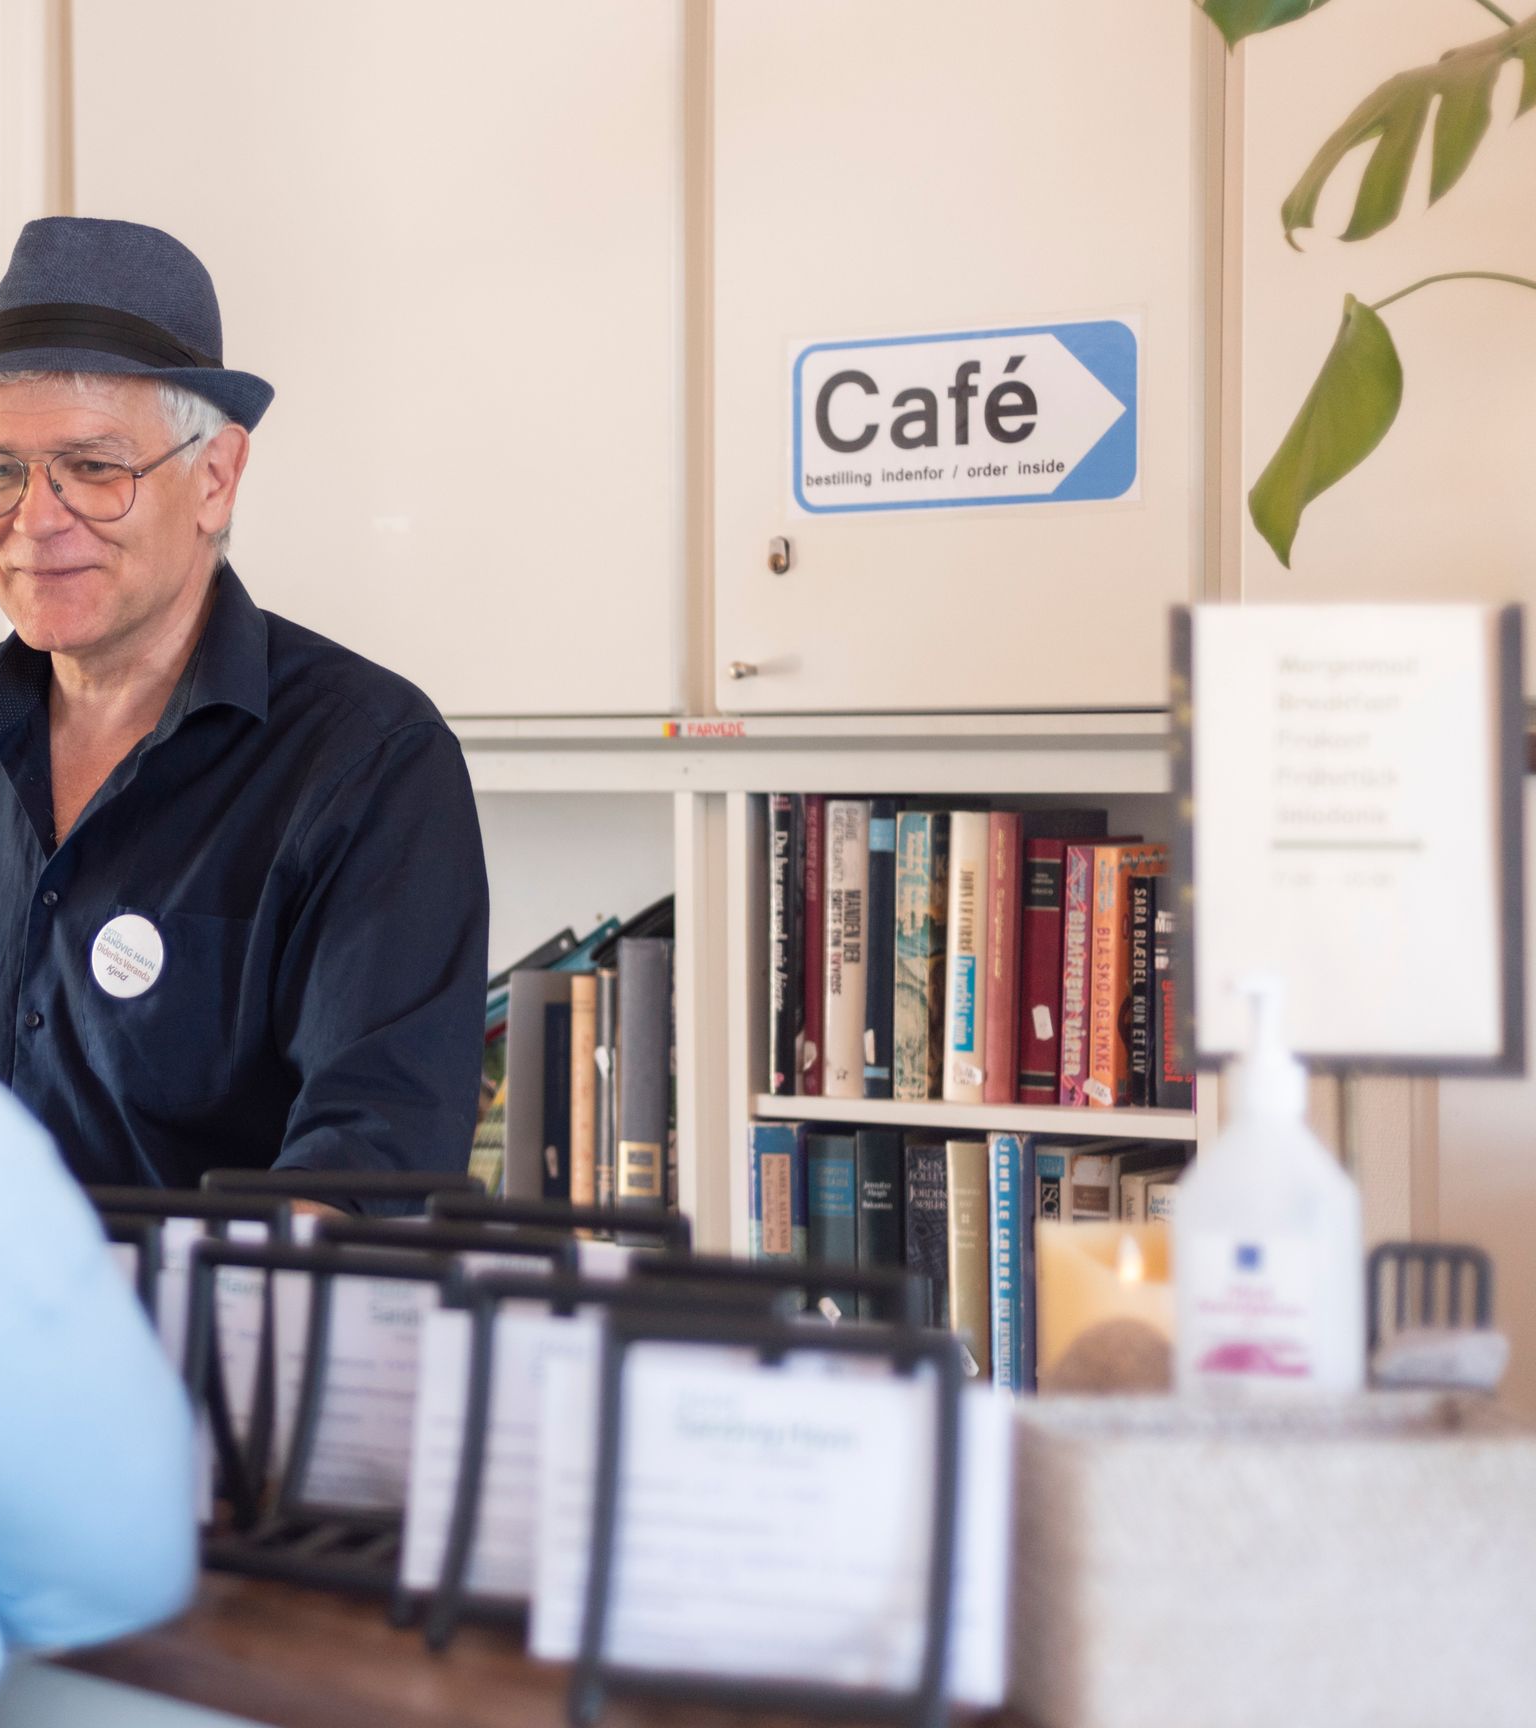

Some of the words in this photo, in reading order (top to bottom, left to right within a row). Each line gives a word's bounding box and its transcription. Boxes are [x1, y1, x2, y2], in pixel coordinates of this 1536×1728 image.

[815, 355, 1038, 453] Café
[806, 471, 872, 488] bestilling
[881, 466, 943, 483] indenfor
[967, 463, 1008, 479] order
[1018, 459, 1065, 475] inside
[843, 889, 861, 939] MANDEN
[1134, 887, 1147, 924] SARA
[102, 932, 133, 956] SANDVIG
[133, 952, 156, 971] HAVN
[843, 942, 861, 964] DER
[1133, 930, 1146, 985] BLÆDEL
[106, 964, 129, 981] Kjeld
[123, 960, 151, 983] Veranda
[1133, 995, 1146, 1023] KUN
[1095, 1025, 1111, 1073] LYKKE
[1133, 1029, 1146, 1044] ET
[1132, 1050, 1146, 1073] LIV
[918, 1158, 943, 1169] KEN
[999, 1144, 1010, 1192] JOHN
[999, 1201, 1010, 1220] LE
[999, 1228, 1012, 1290] CARRÉ
